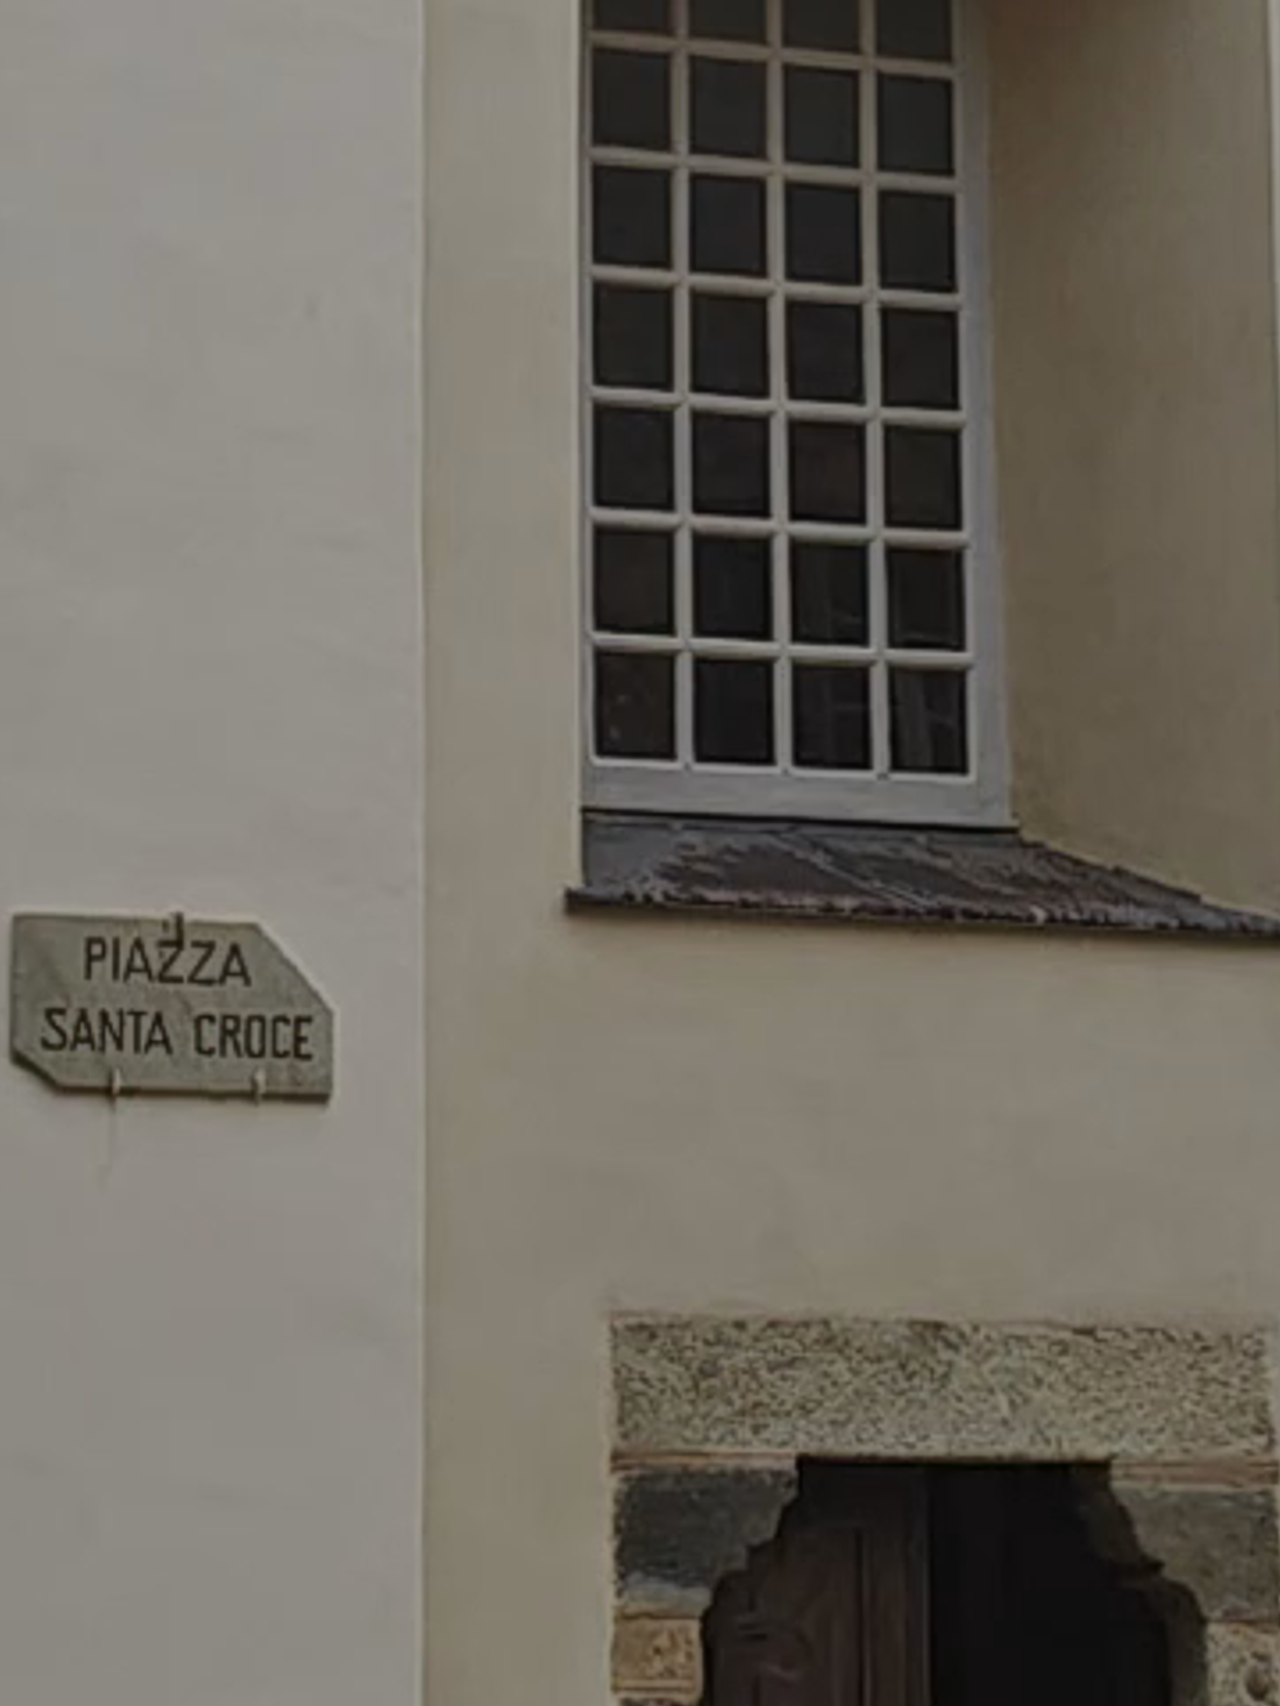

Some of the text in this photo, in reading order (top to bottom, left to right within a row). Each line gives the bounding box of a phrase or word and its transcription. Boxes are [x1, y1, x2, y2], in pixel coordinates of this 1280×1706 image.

[84, 936, 252, 986] PIAZZA
[40, 1007, 313, 1061] SANTA CROCE
